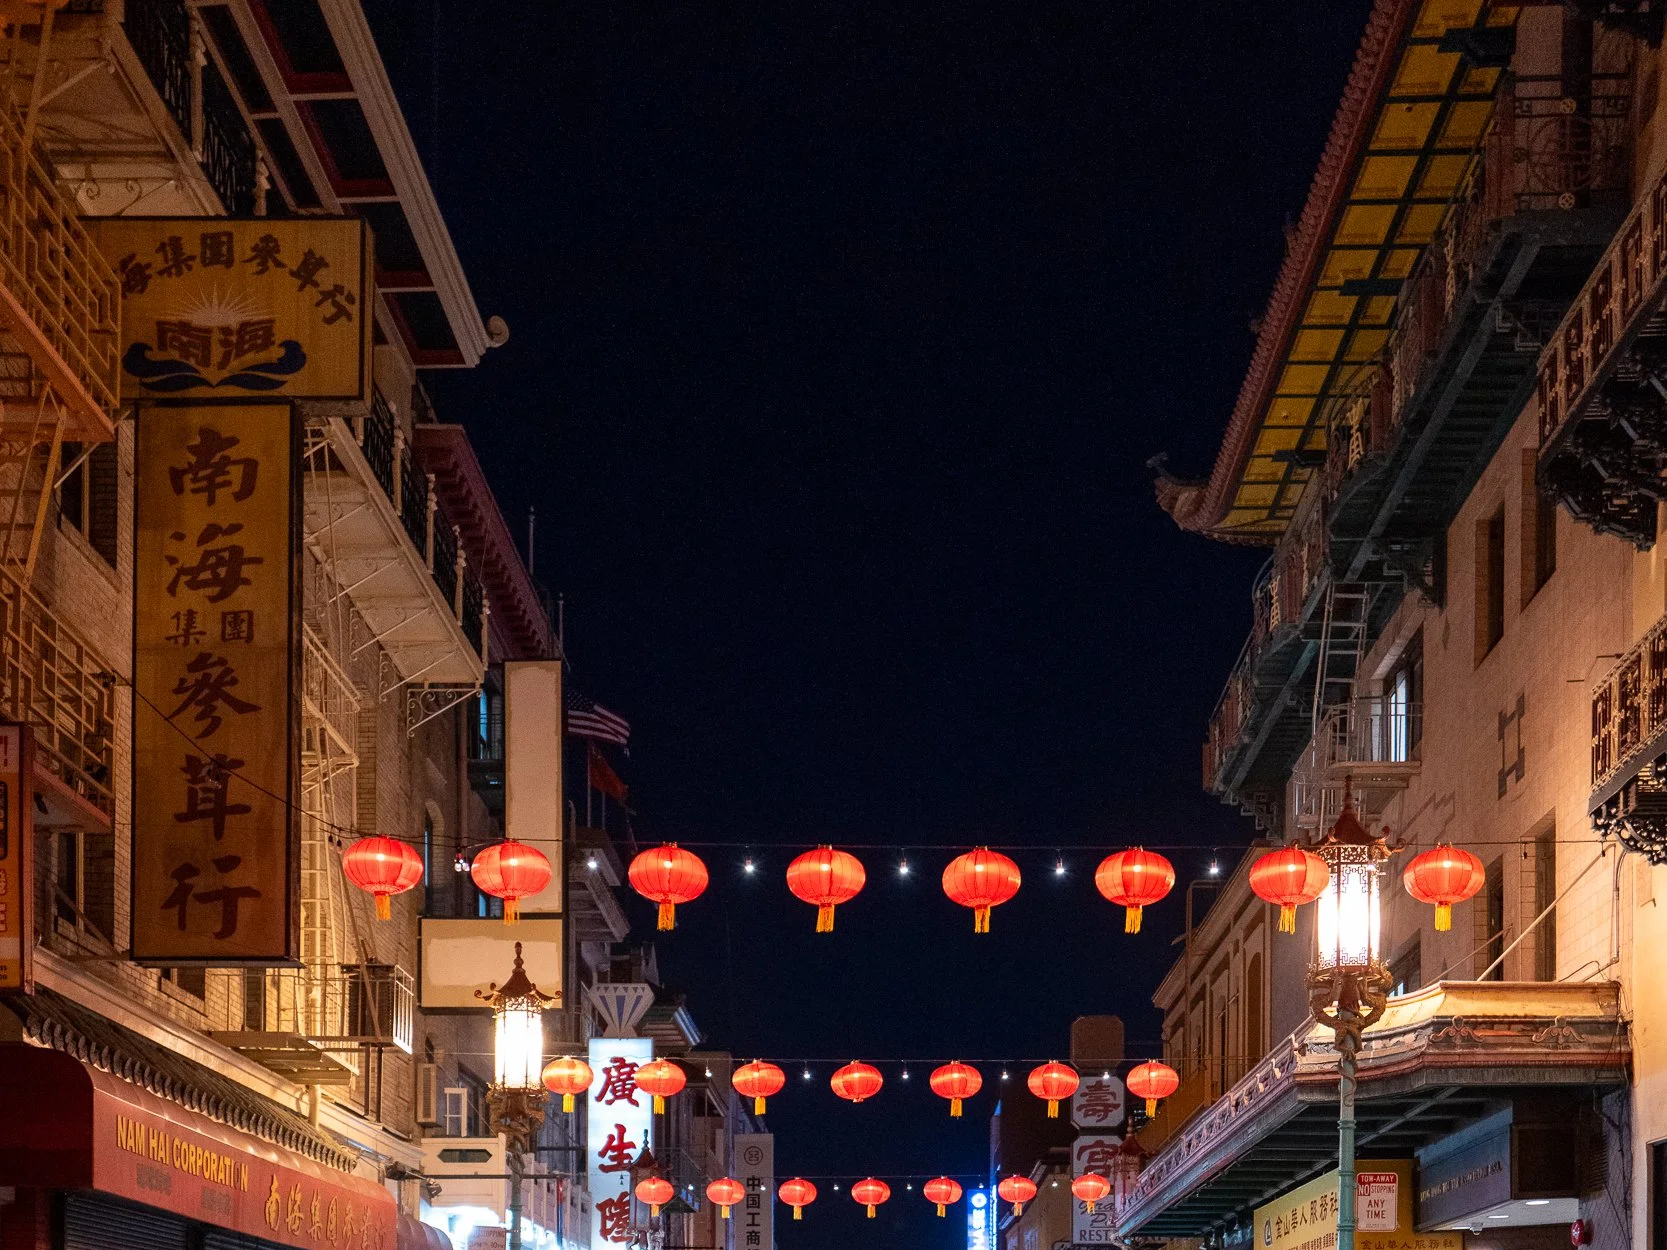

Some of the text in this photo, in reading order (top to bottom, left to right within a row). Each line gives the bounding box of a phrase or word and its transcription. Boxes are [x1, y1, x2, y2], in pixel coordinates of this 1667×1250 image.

[154, 319, 276, 371] 南海
[164, 427, 264, 604] 南海
[164, 608, 255, 645] 集團
[160, 651, 263, 941] 參茸行
[116, 1114, 146, 1156] NAM
[147, 1126, 169, 1165] HAI
[173, 1136, 249, 1193] CORPORATION
[1358, 1184, 1395, 1196] NO STOPPING
[1367, 1199, 1386, 1208] ANY
[1365, 1209, 1387, 1219] TIME
